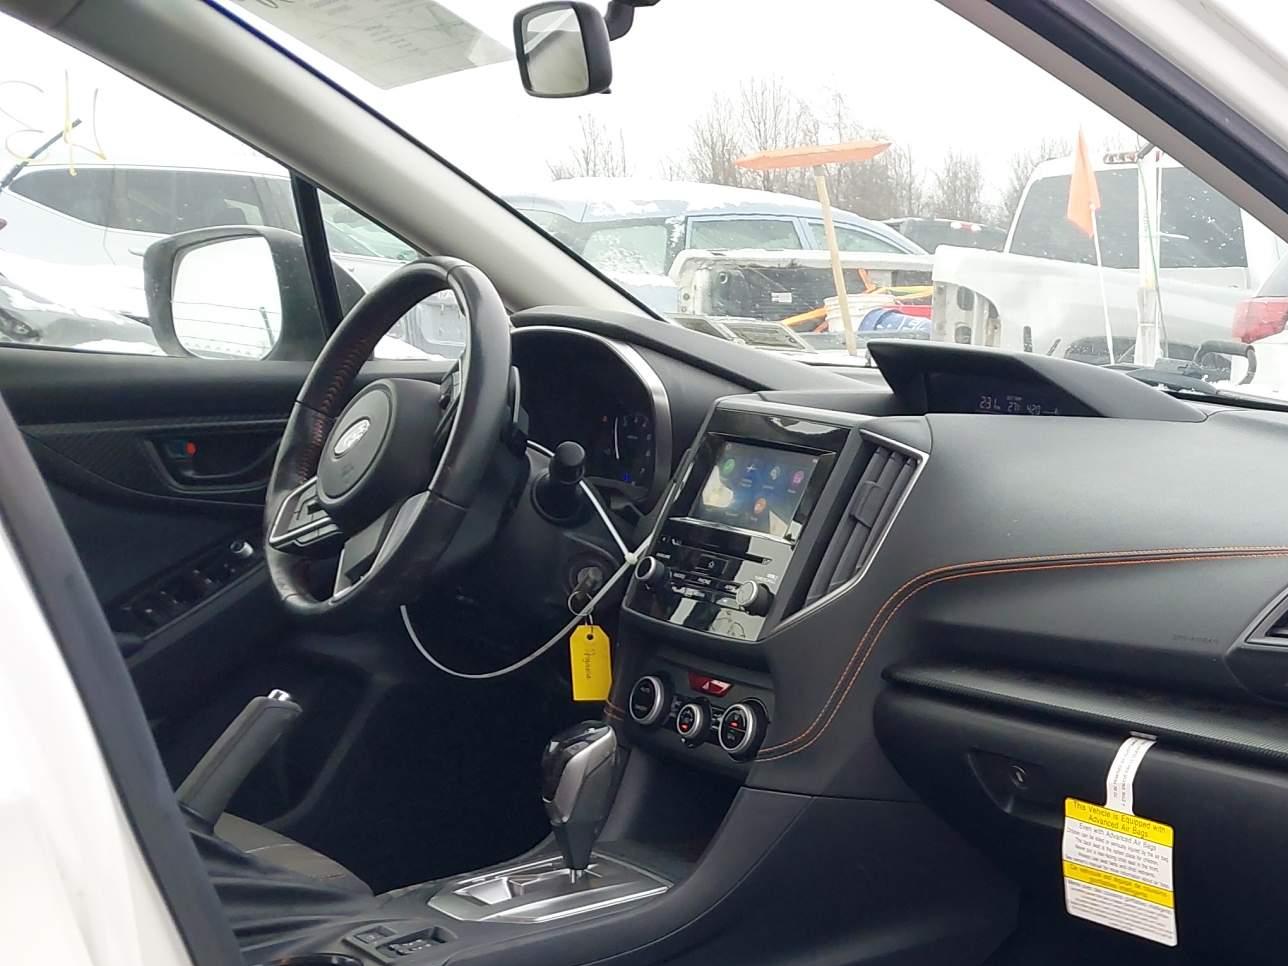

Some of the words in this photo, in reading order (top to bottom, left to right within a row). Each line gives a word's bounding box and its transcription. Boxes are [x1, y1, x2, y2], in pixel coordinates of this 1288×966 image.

[1073, 800, 1086, 811] This
[1088, 804, 1112, 818] Vehicle
[1113, 813, 1119, 821] is
[1120, 814, 1151, 830] Equipped
[1152, 824, 1166, 833] with
[1088, 814, 1119, 830] Advanced
[1121, 822, 1130, 832] Air
[1132, 825, 1149, 838] Bags
[1106, 830, 1133, 844] Advanced
